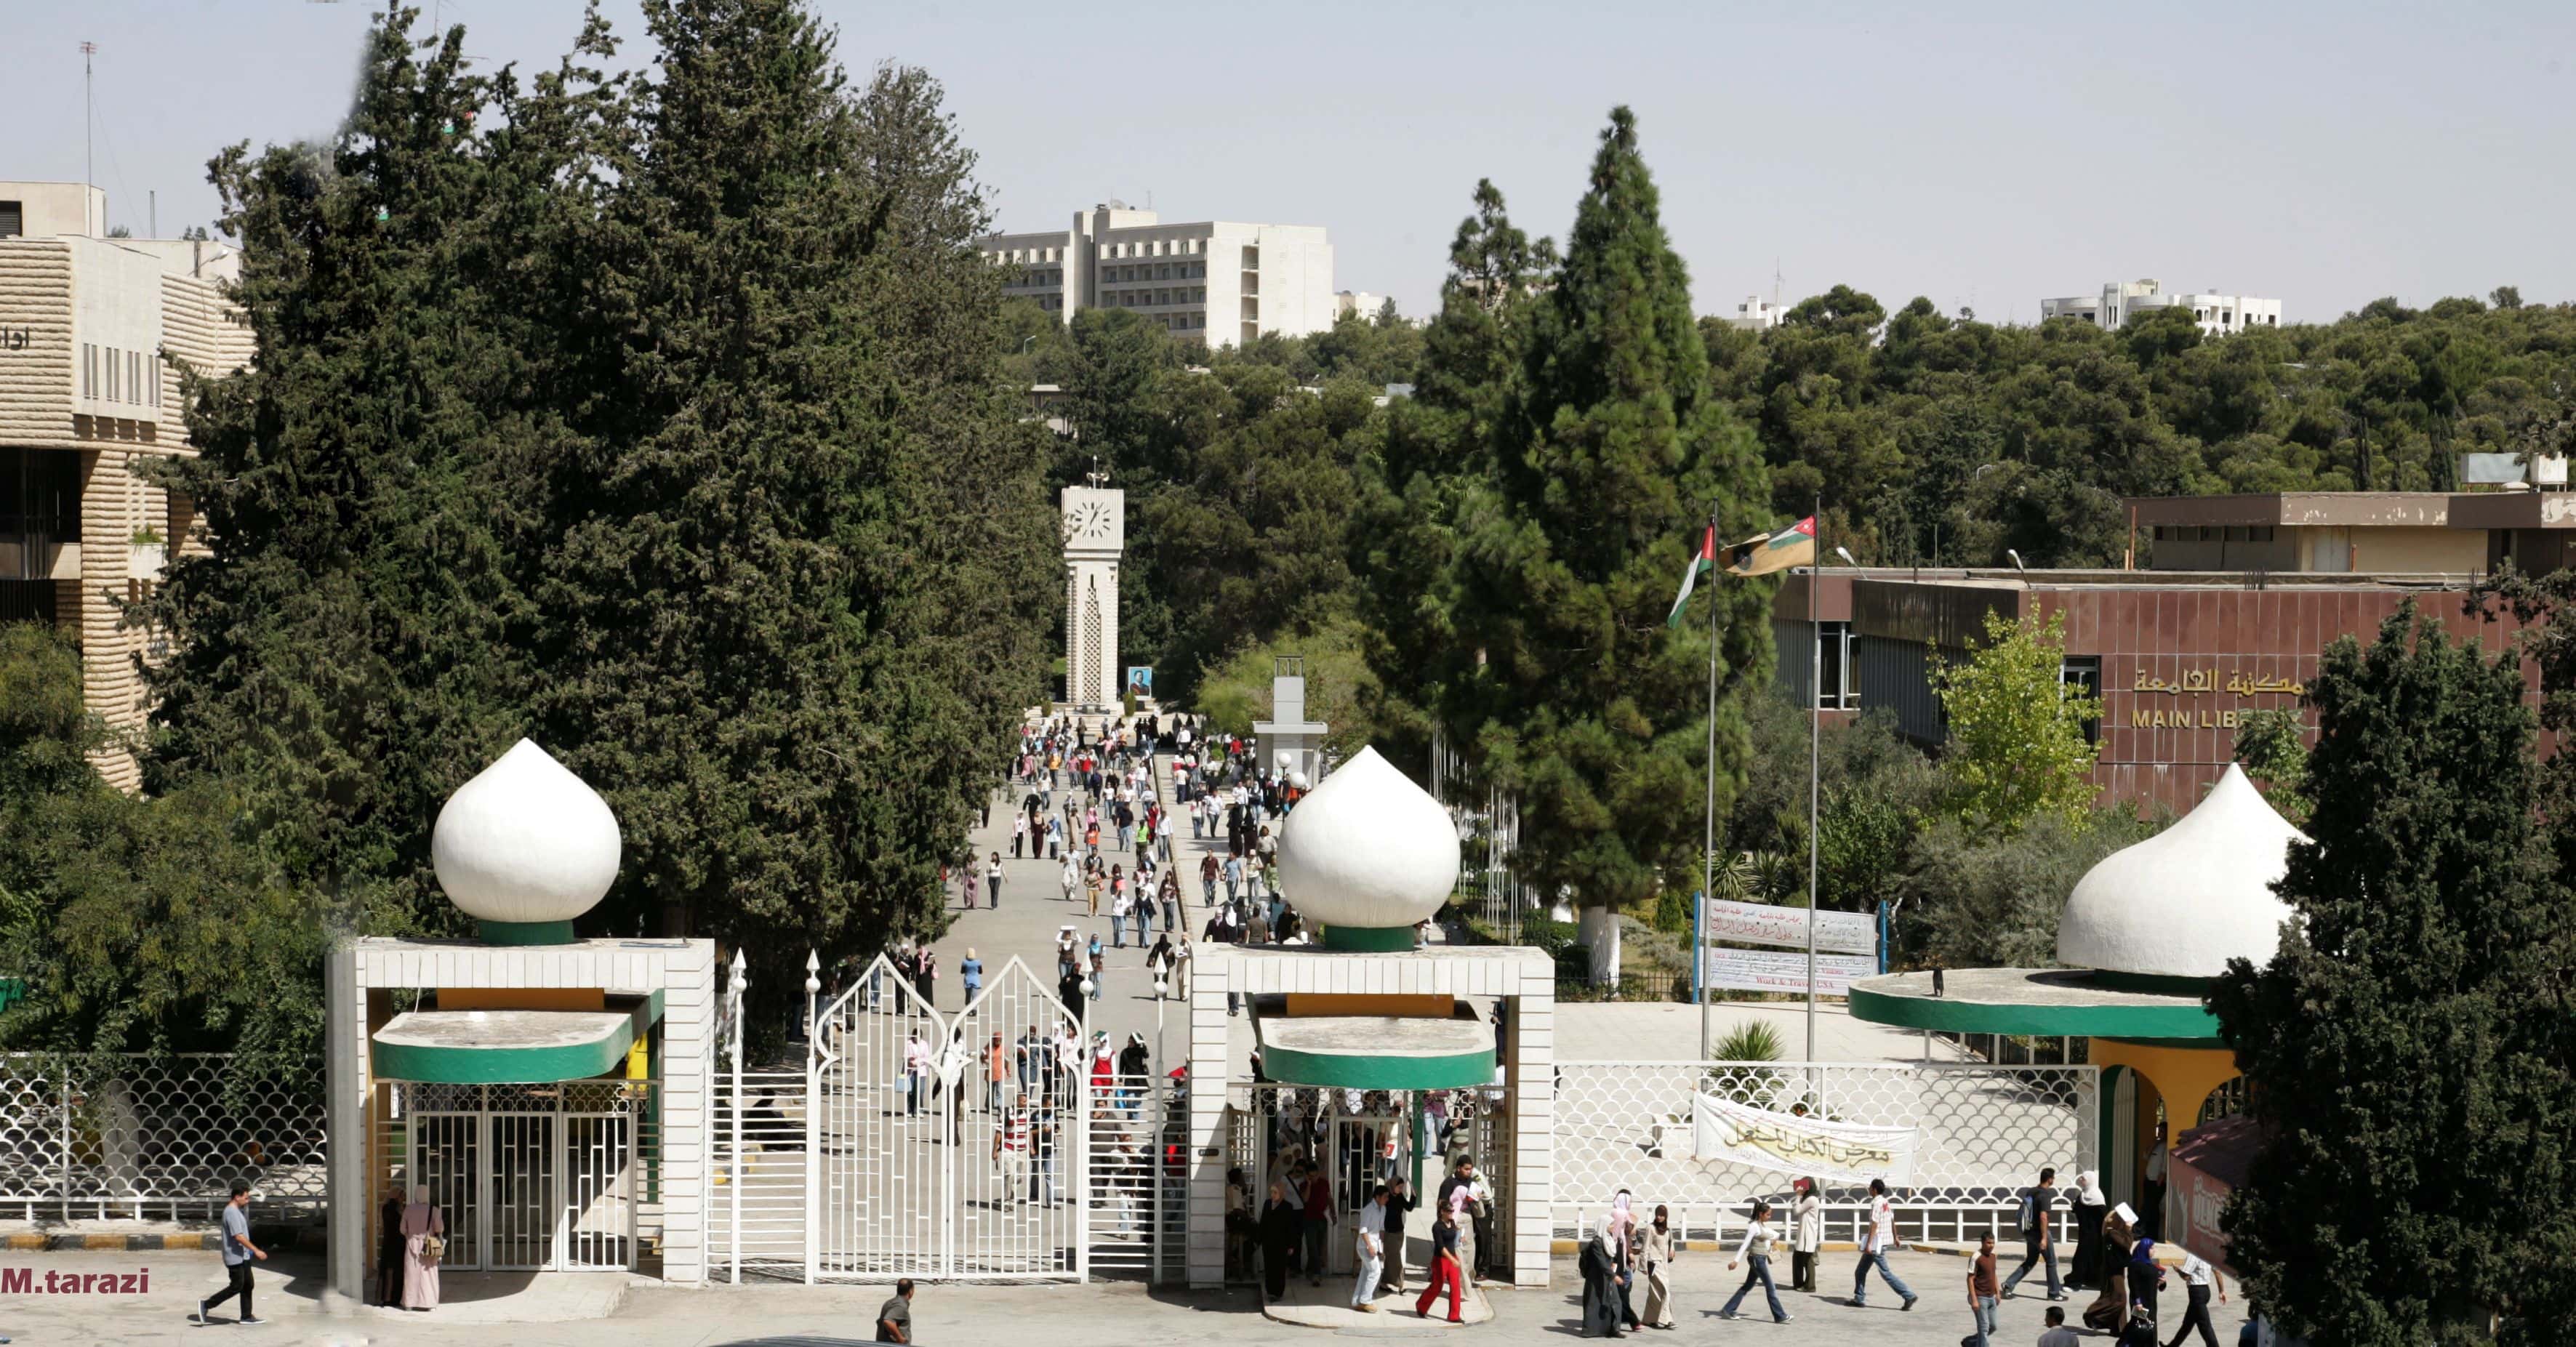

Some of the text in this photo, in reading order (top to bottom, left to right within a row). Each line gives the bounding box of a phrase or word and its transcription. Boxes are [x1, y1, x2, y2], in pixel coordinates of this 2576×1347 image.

[2133, 668, 2305, 698] مكتبة الجامعة
[2131, 709, 2191, 728] MAIN
[1778, 1133, 1831, 1157] الكتاب
[1831, 1144, 1890, 1167] معرض
